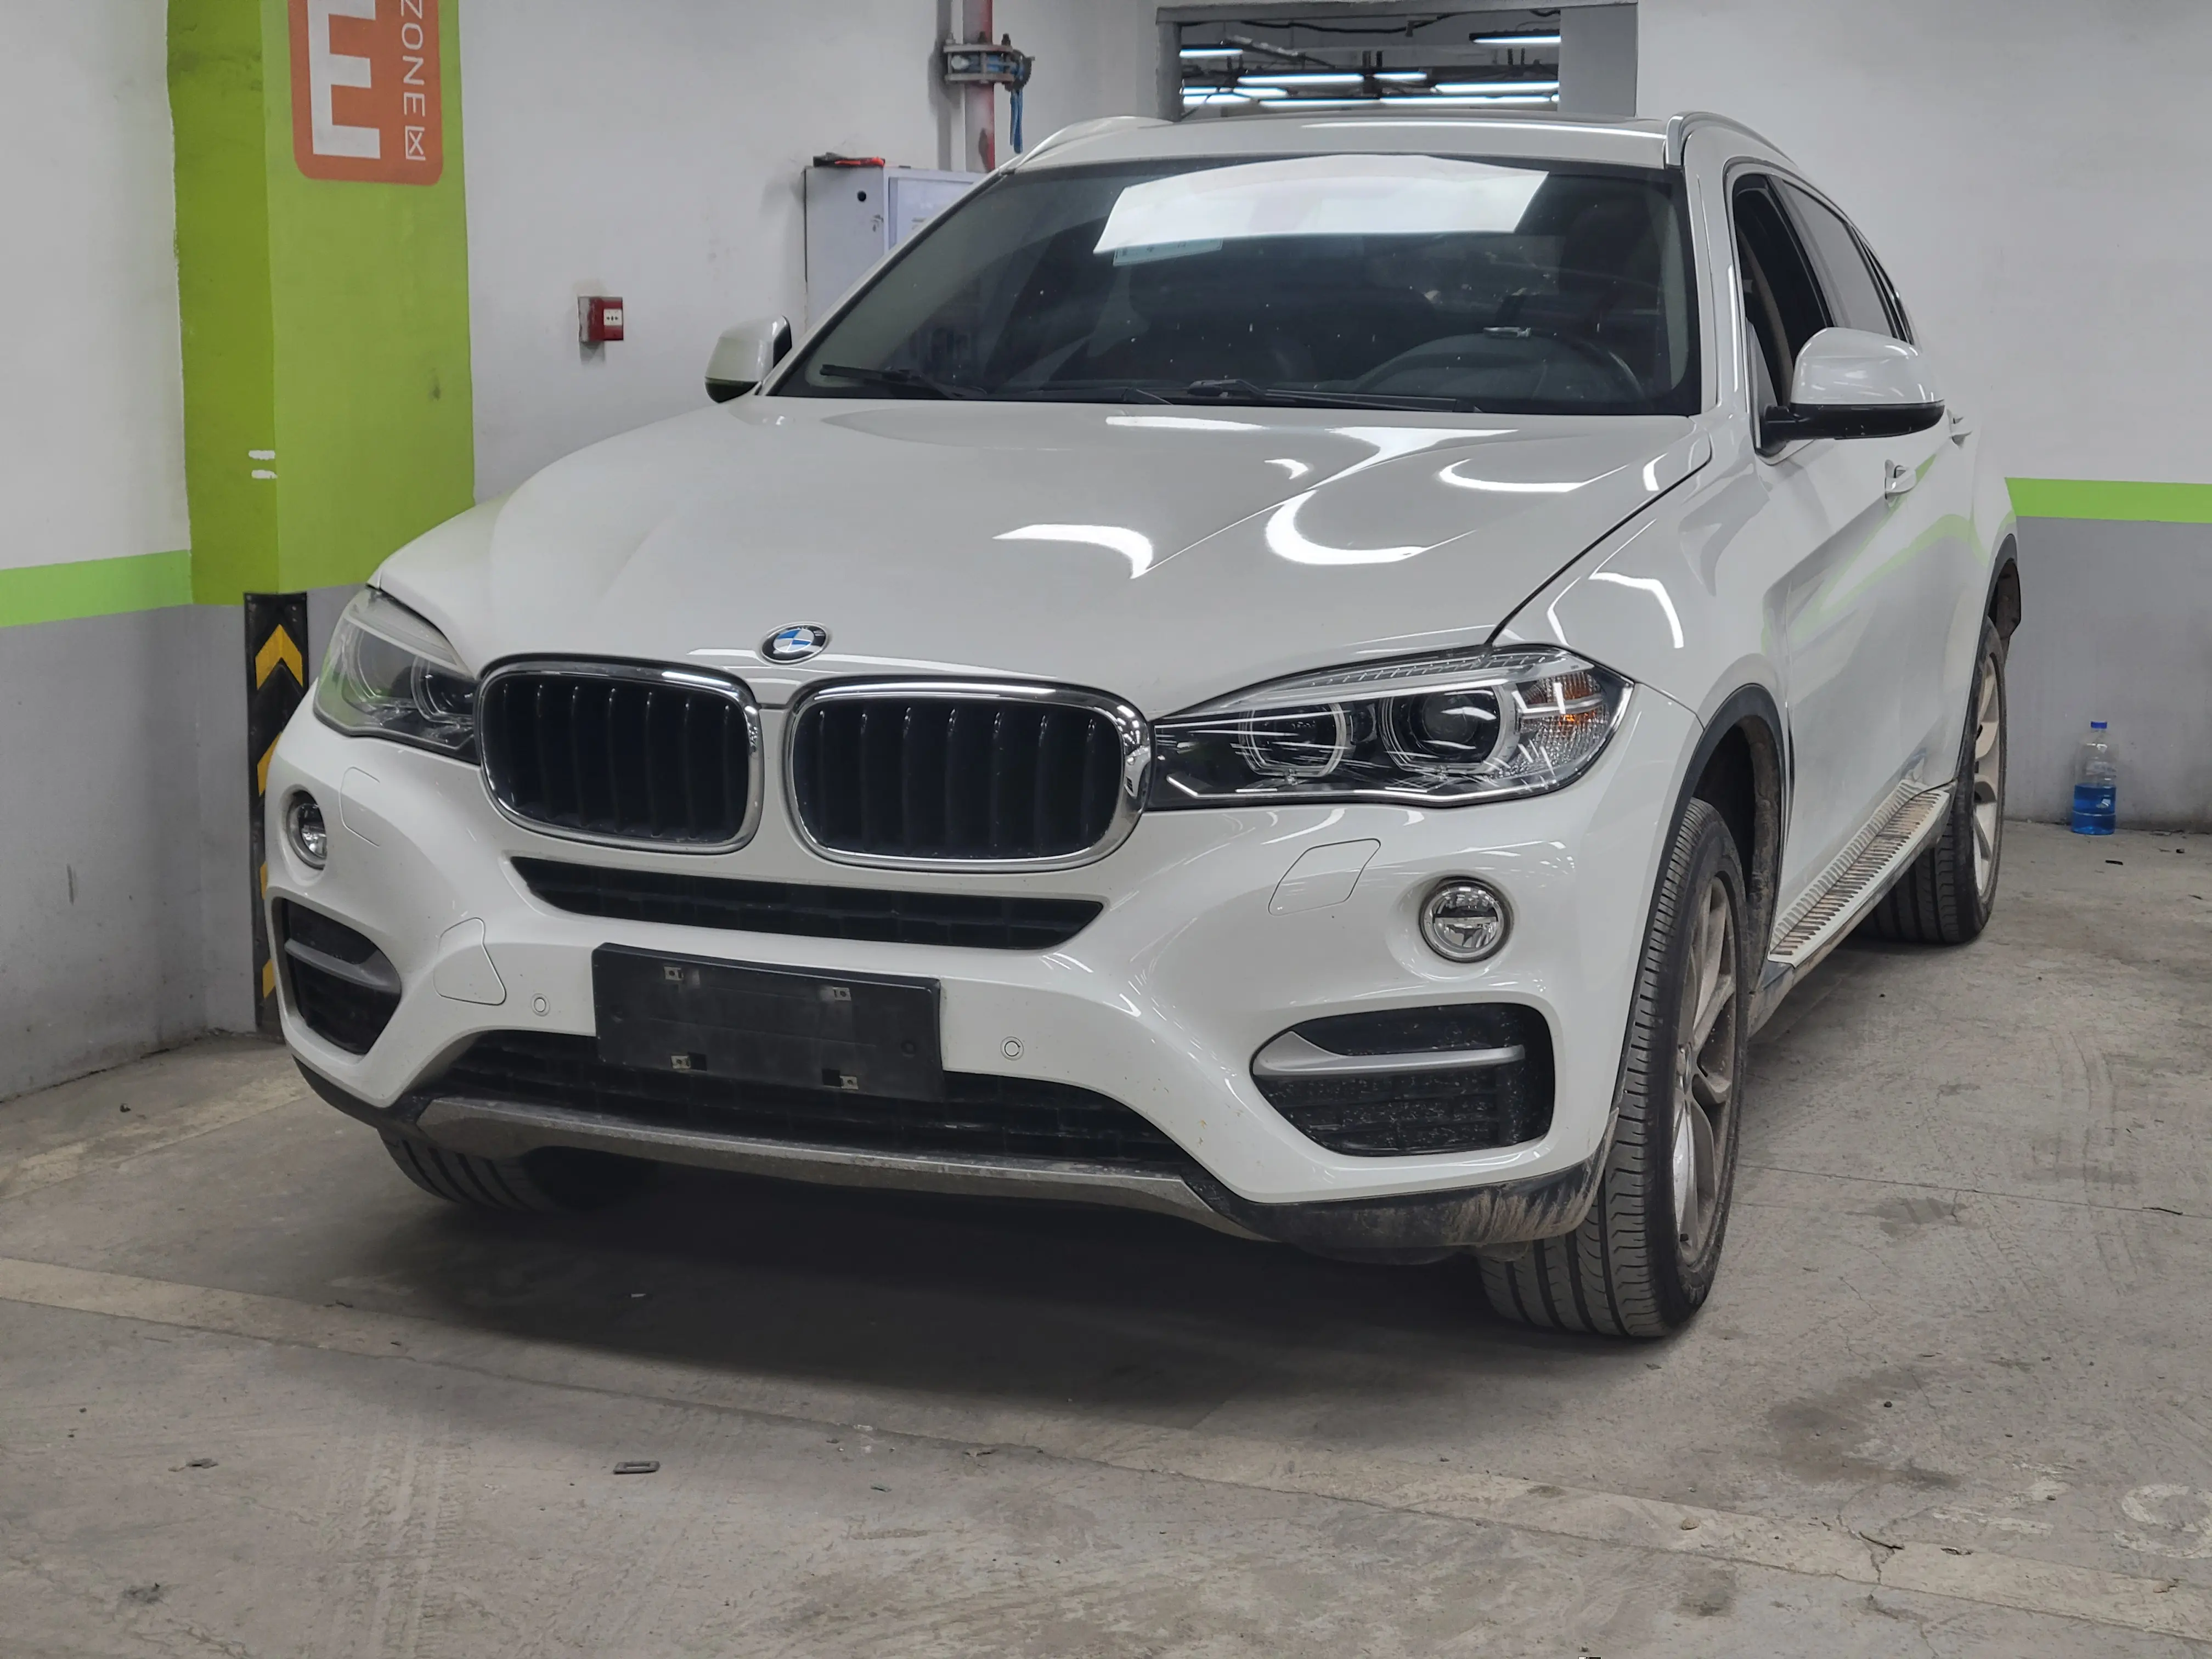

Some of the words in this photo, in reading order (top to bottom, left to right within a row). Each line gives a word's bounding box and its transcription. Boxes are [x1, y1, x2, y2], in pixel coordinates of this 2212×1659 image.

[307, 0, 381, 159] E
[400, 0, 425, 117] ZONE
[405, 126, 426, 160] 区
